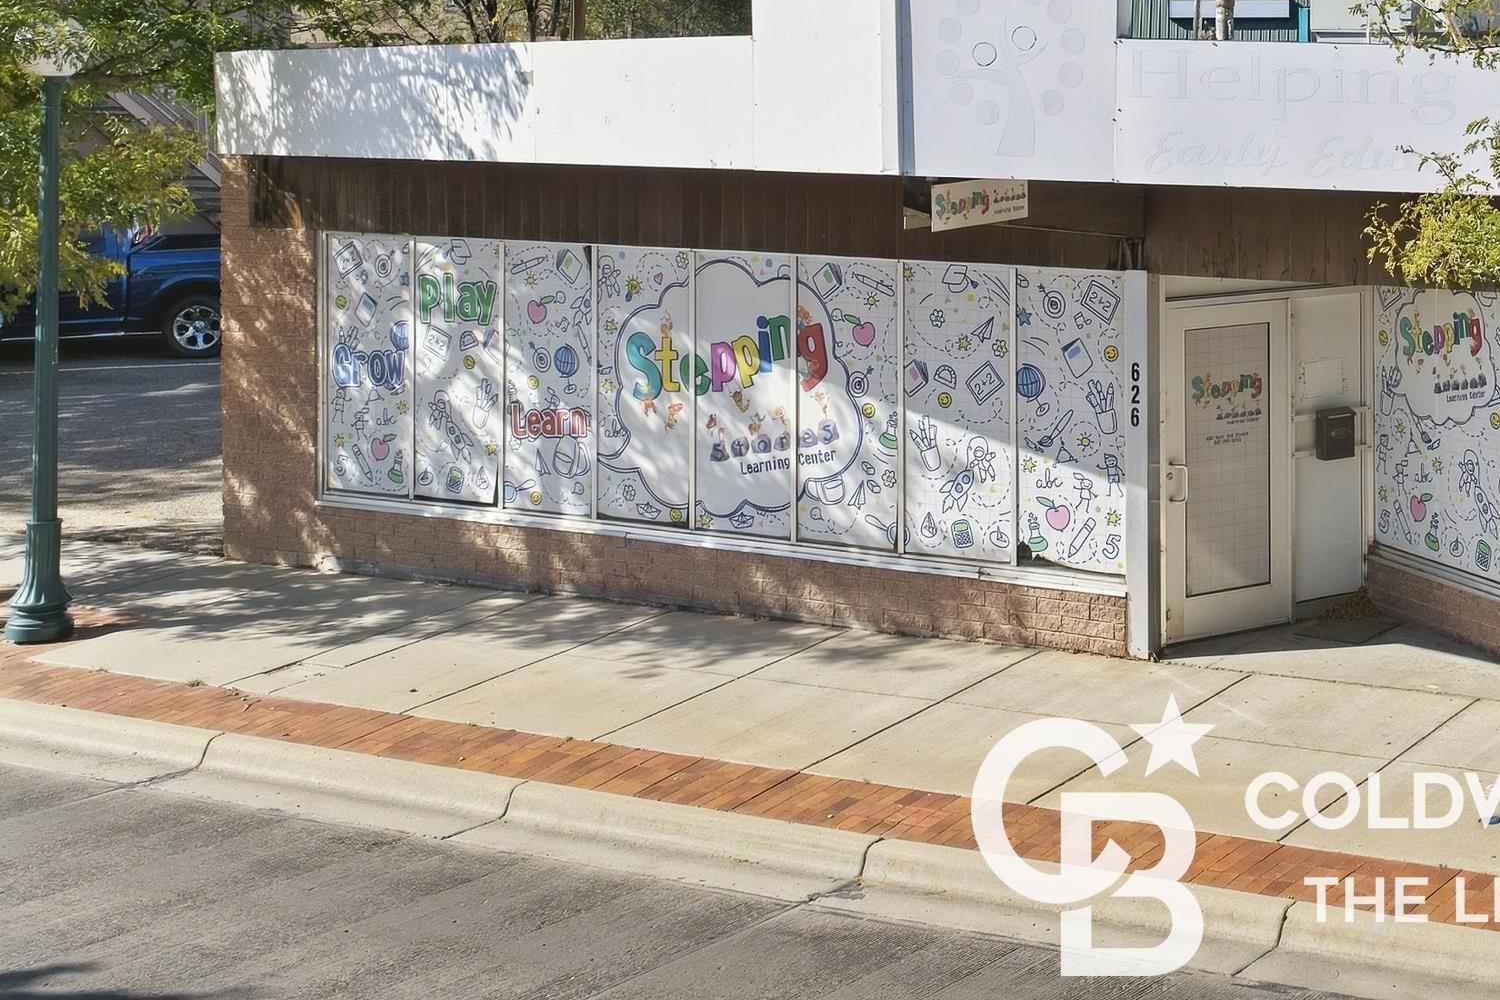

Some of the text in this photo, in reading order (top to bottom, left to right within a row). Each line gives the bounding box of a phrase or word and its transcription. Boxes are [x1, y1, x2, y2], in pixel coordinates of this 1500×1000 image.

[1128, 49, 1457, 124] Helping
[418, 273, 497, 326] Play
[1400, 312, 1482, 356] Stepping
[332, 343, 406, 388] Grow
[626, 315, 829, 400] Stepping
[511, 400, 589, 440] Learn
[740, 449, 837, 476] Learning Center
[1036, 468, 1063, 489] abc
[1102, 533, 1122, 560] 5
